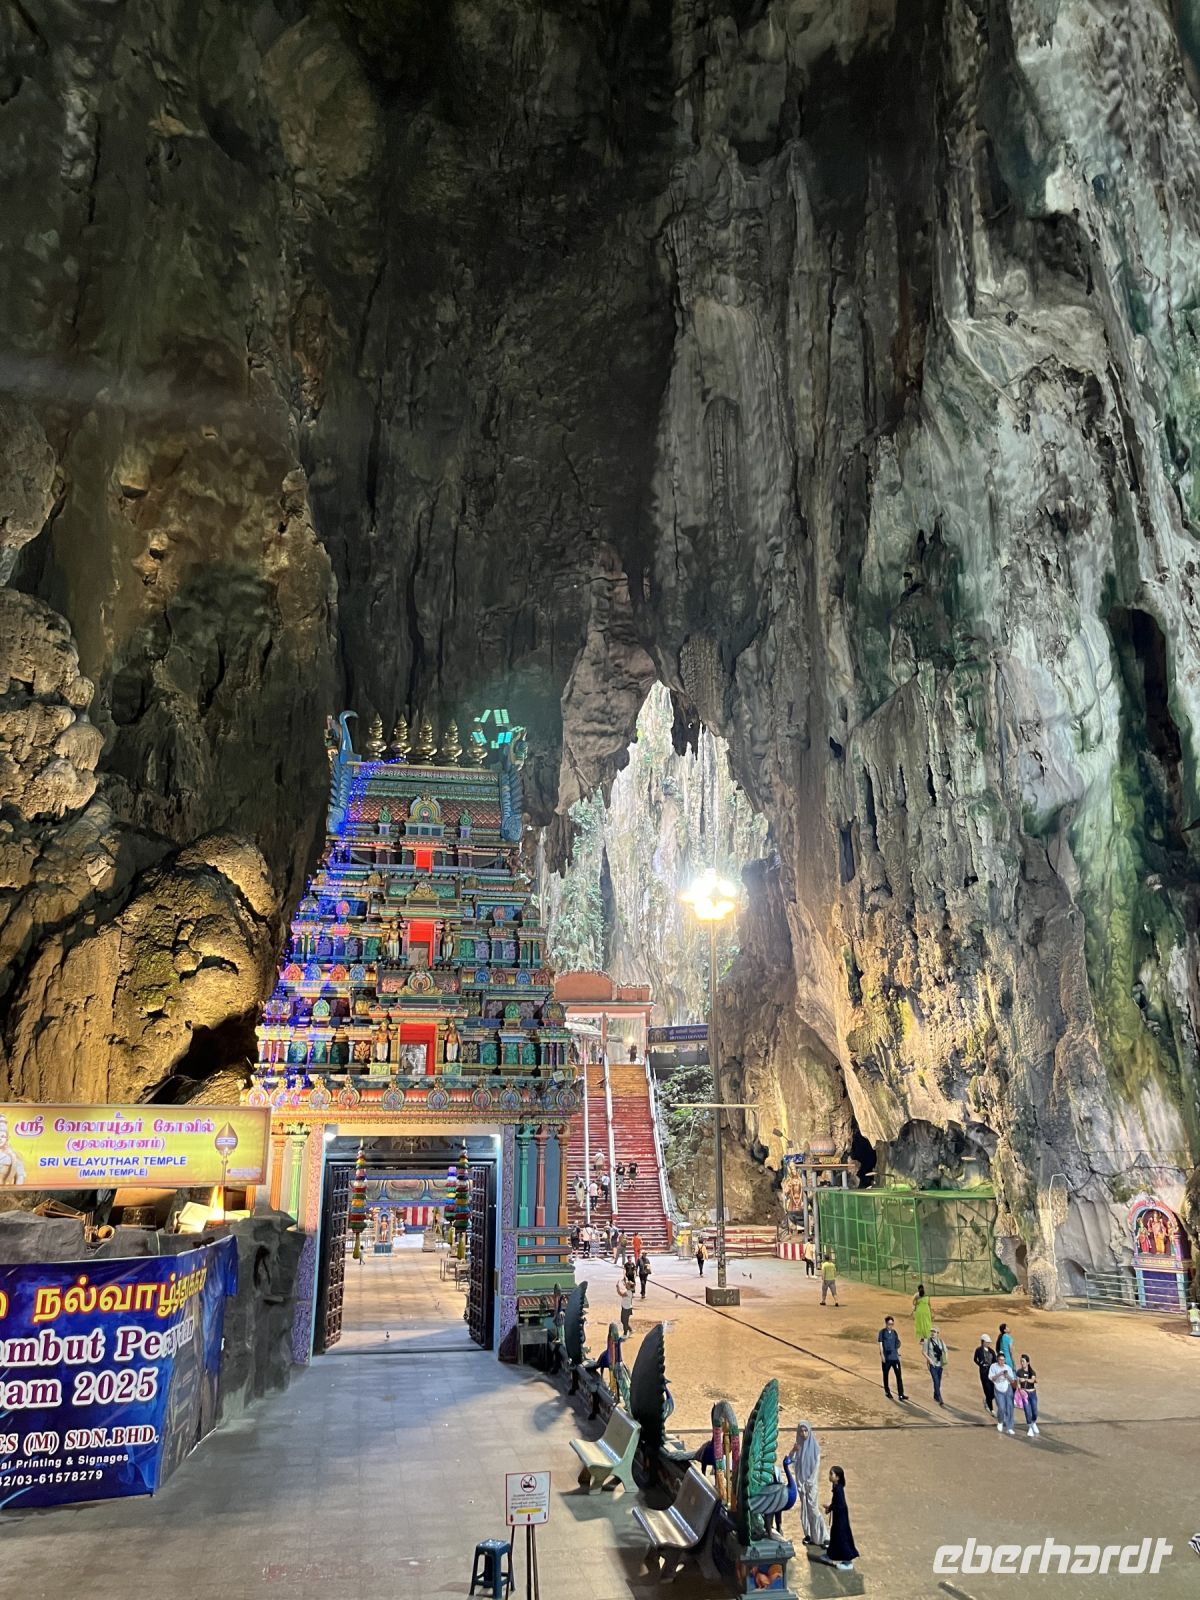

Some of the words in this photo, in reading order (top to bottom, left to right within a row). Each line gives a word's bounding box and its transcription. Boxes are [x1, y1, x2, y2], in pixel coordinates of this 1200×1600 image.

[153, 1118, 215, 1133] கோவில்
[39, 1157, 59, 1167] SRI
[63, 1156, 140, 1167] VELAYUTHAR
[144, 1156, 187, 1166] TEMPLE
[79, 1169, 106, 1178] (MAIN
[109, 1168, 148, 1177] TEMPLE)
[0, 1328, 104, 1365] mbut
[0, 1380, 60, 1407] am
[74, 1369, 157, 1405] 2025
[24, 1432, 59, 1456] (M)
[16, 1457, 61, 1469] Printing
[66, 1456, 73, 1465] &
[78, 1453, 128, 1465] Signages
